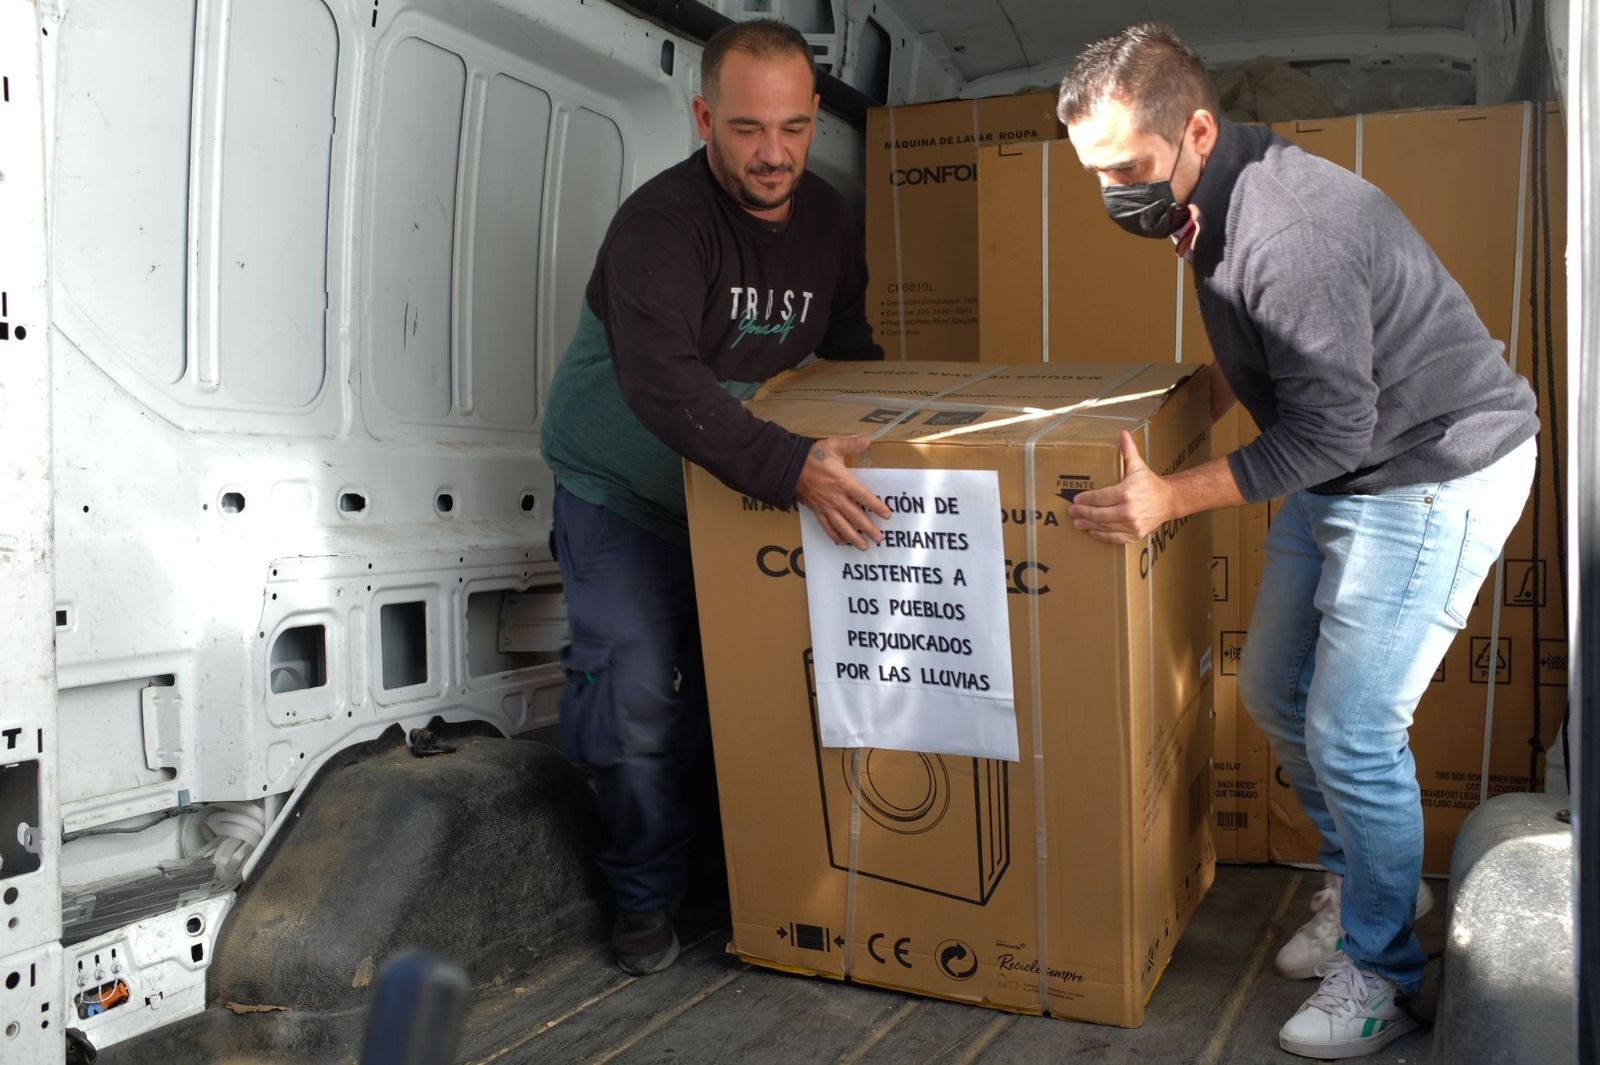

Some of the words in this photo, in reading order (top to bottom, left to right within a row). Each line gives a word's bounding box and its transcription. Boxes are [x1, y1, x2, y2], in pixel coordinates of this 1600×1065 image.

[939, 136, 954, 145] DE
[956, 133, 993, 144] LAVAR
[999, 129, 1039, 140] ROUPA
[887, 282, 935, 294] C6010L
[1056, 480, 1095, 489] FRENTE
[860, 491, 925, 514] CIÓN
[935, 497, 960, 515] DE
[1001, 508, 1059, 527] UPA
[842, 562, 944, 585] ASISTENTES
[953, 568, 967, 587] A
[848, 596, 880, 615] LOS
[889, 599, 965, 621] PUEBLOS
[847, 629, 973, 656] PERJUDICADOS
[836, 662, 870, 680] POR
[879, 665, 911, 683] LAS
[921, 667, 990, 691] LLUVIAS
[1466, 783, 1482, 791] COT
[1467, 773, 1482, 783] DOW
